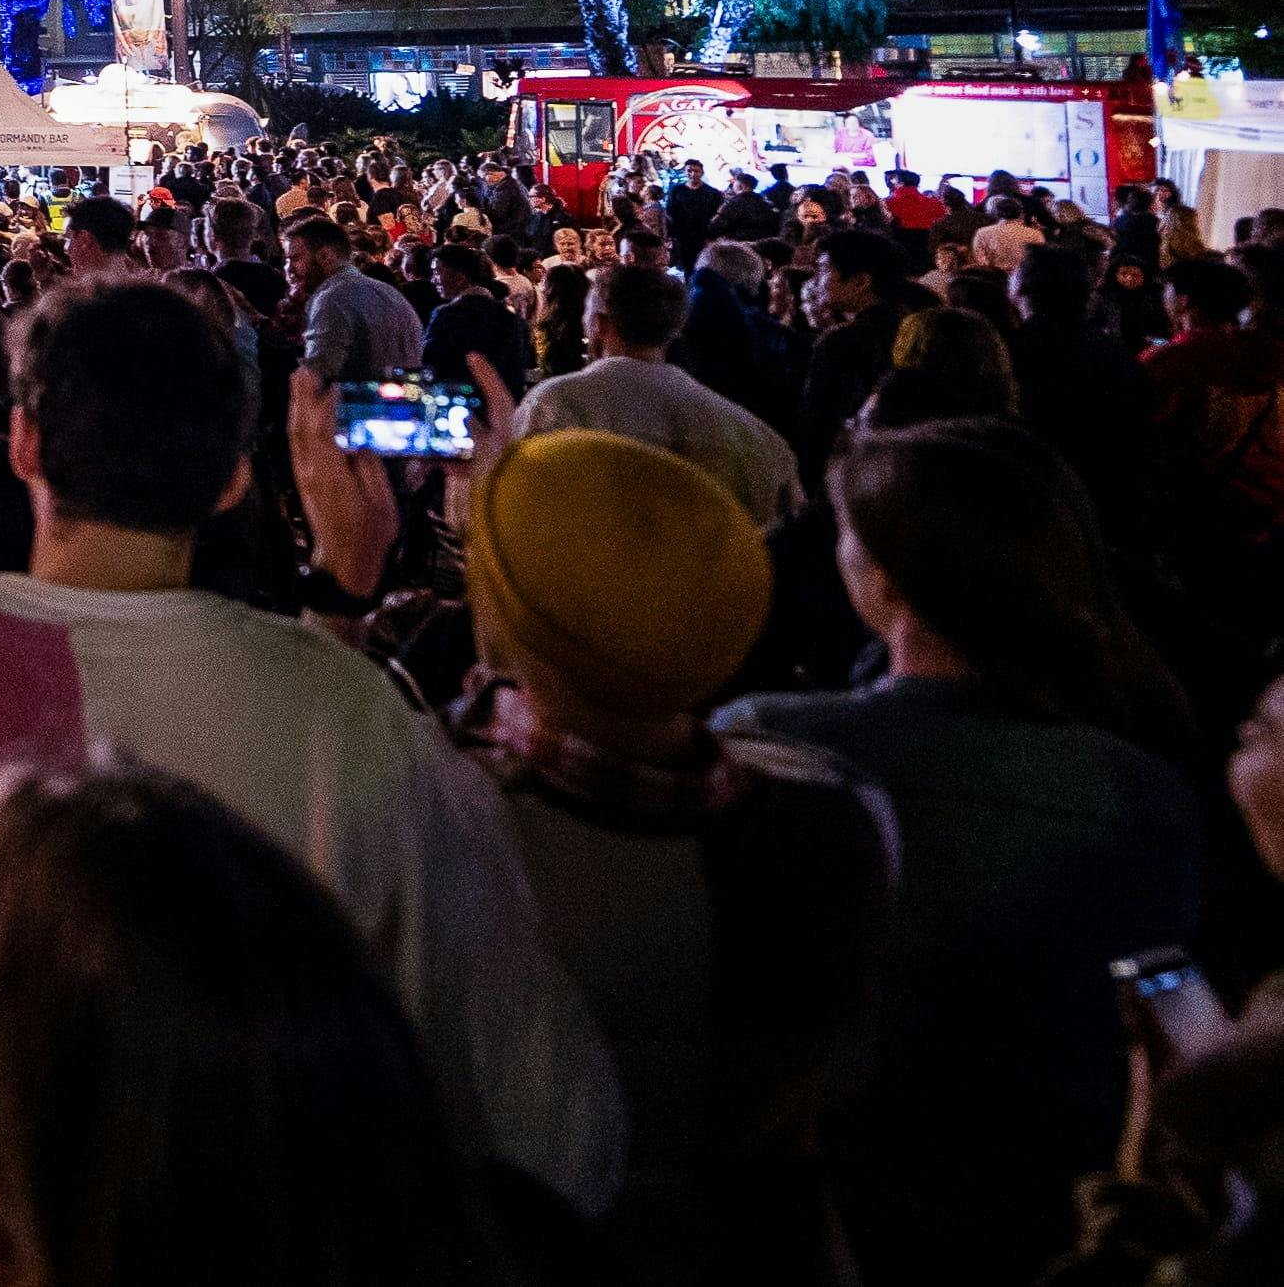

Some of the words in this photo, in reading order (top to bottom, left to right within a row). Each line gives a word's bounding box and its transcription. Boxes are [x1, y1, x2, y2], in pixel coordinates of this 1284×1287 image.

[1022, 85, 1047, 96] with
[1049, 85, 1074, 96] love
[49, 134, 69, 145] BAR
